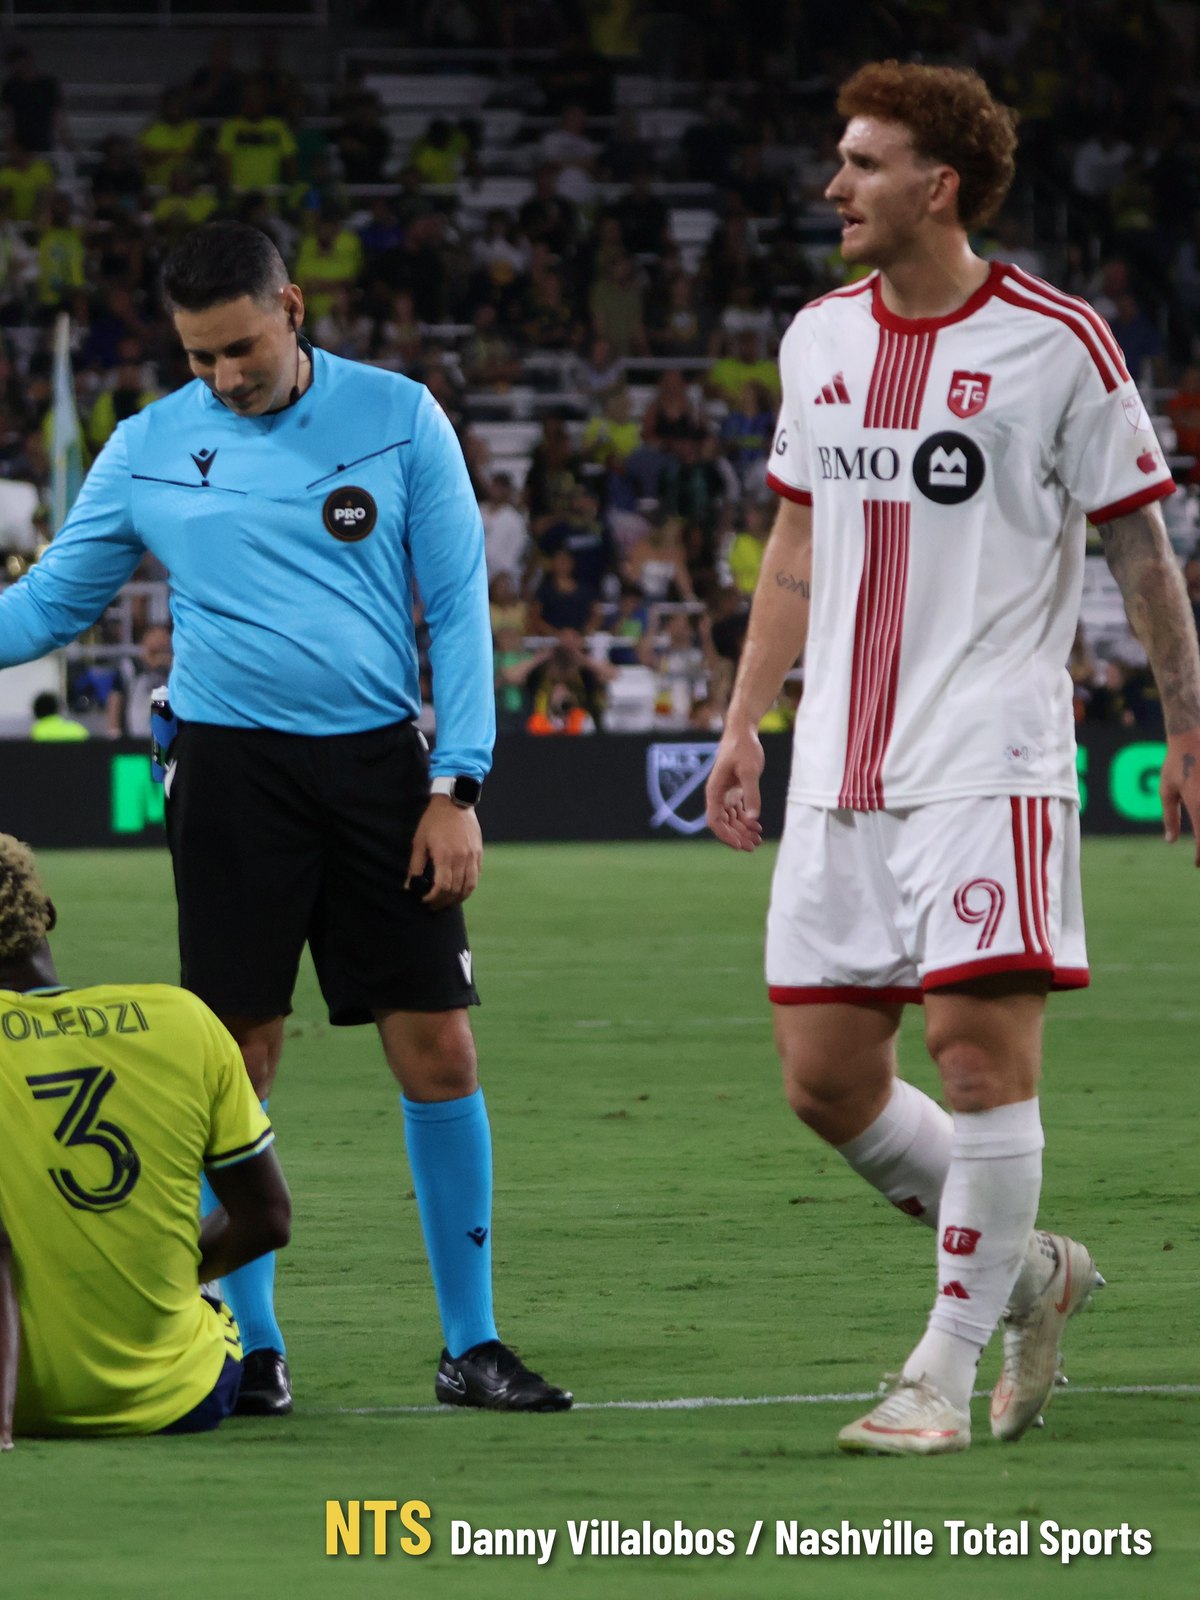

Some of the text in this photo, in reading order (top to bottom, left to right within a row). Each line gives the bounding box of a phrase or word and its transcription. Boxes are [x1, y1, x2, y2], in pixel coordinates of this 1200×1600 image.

[817, 446, 900, 481] BMO
[334, 507, 366, 520] PRO
[953, 878, 1006, 950] 9
[25, 1066, 141, 1213] 3
